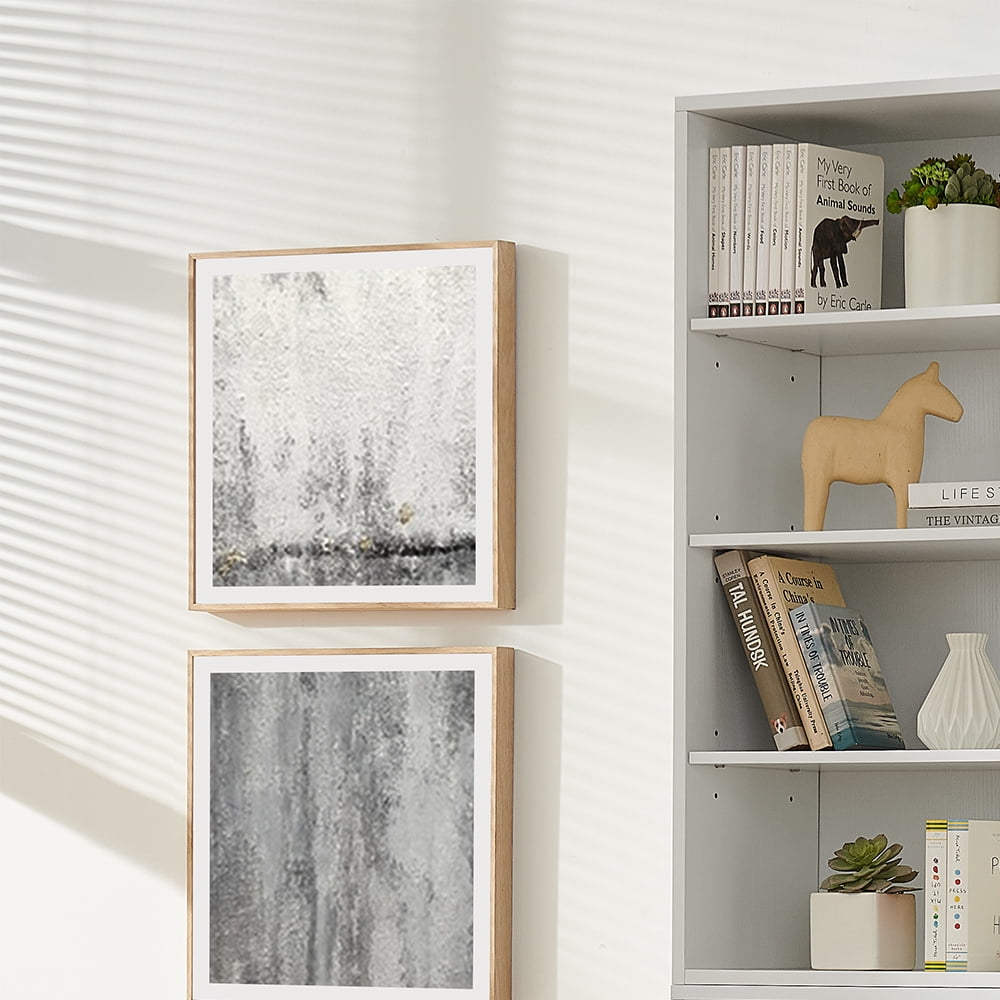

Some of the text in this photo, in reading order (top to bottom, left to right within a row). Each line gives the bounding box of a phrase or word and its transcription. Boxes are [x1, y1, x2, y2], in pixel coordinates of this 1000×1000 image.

[817, 157, 852, 179] My Very
[817, 175, 872, 196] First Book of
[816, 195, 875, 214] Animal Sounds
[817, 292, 828, 309] by
[831, 294, 846, 309] Eric
[848, 297, 871, 311] Carle
[926, 516, 950, 526] THE
[778, 570, 824, 590] A Course in
[762, 579, 773, 600] Course
[774, 612, 785, 635] China's
[783, 589, 815, 605] China's
[728, 582, 769, 671] TAL HUNDSK
[829, 617, 859, 636] IN TIMES
[844, 634, 854, 650] OF
[795, 611, 833, 702] IN TIMES OF TROUBLE
[839, 649, 871, 669] TROUBLE
